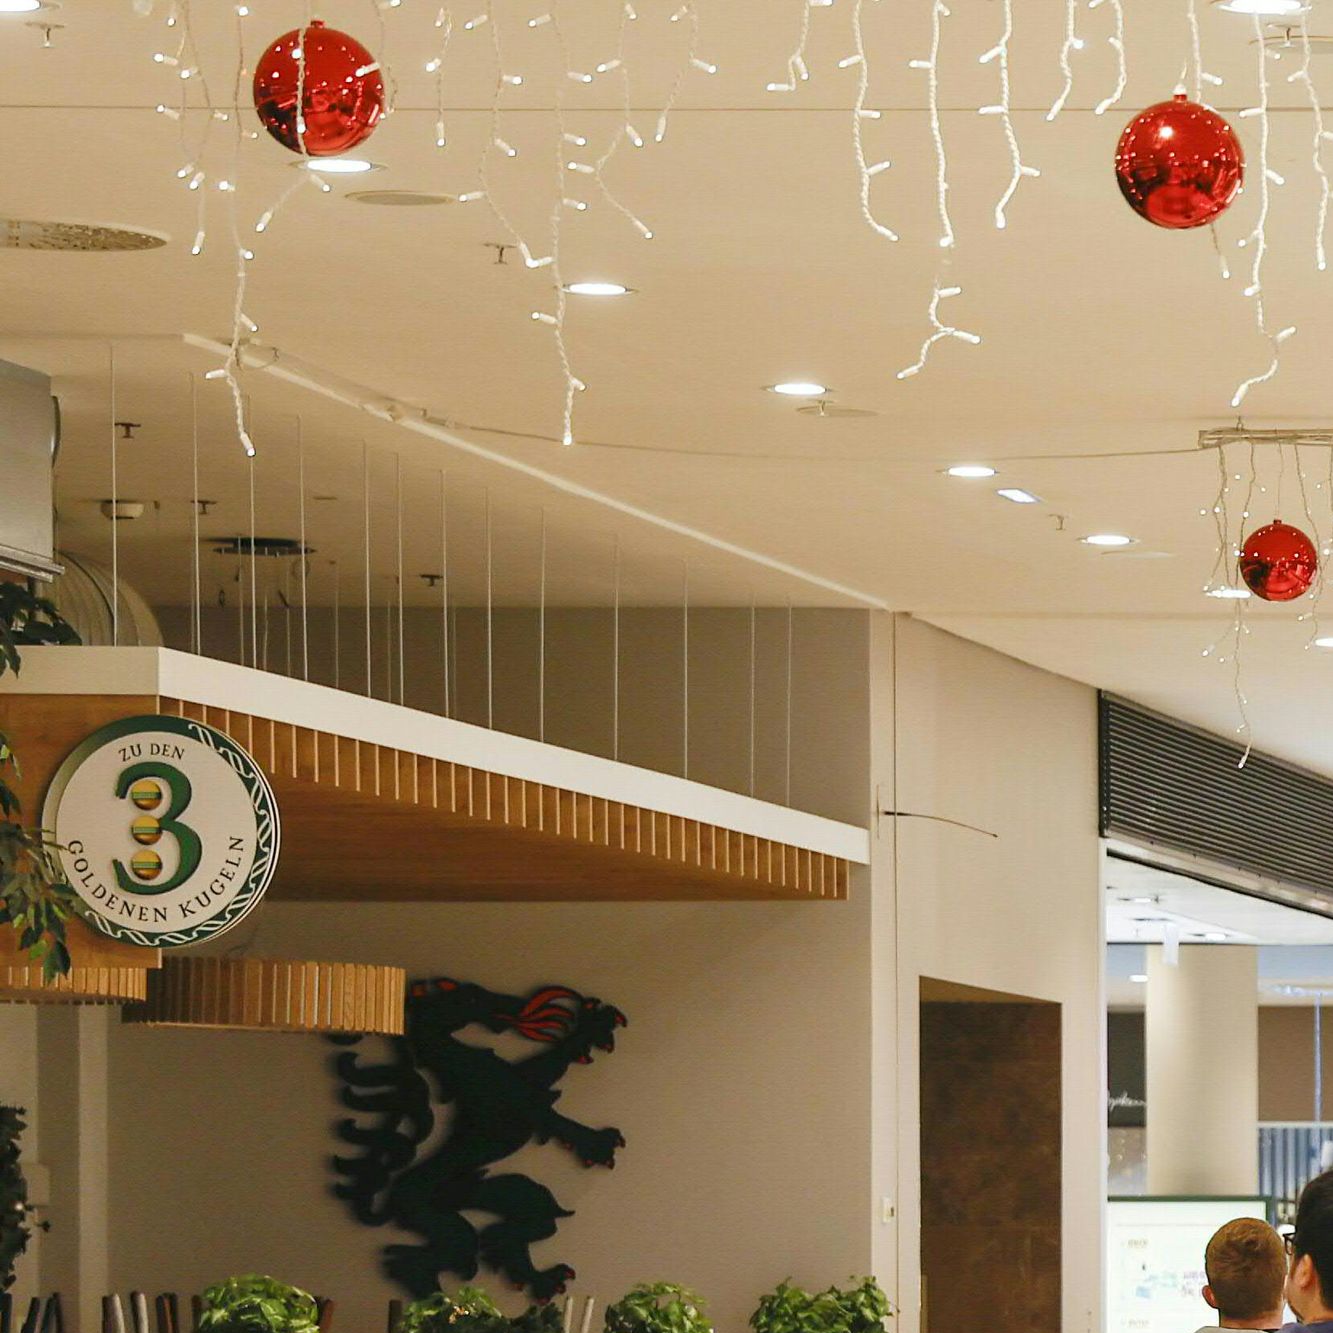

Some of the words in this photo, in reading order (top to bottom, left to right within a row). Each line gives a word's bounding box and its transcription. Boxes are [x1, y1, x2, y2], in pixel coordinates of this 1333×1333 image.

[119, 743, 143, 762] ZU
[149, 742, 185, 760] DEN
[113, 761, 203, 896] 3
[68, 839, 168, 923] GOLDENEN
[178, 836, 245, 918] KUGELN
